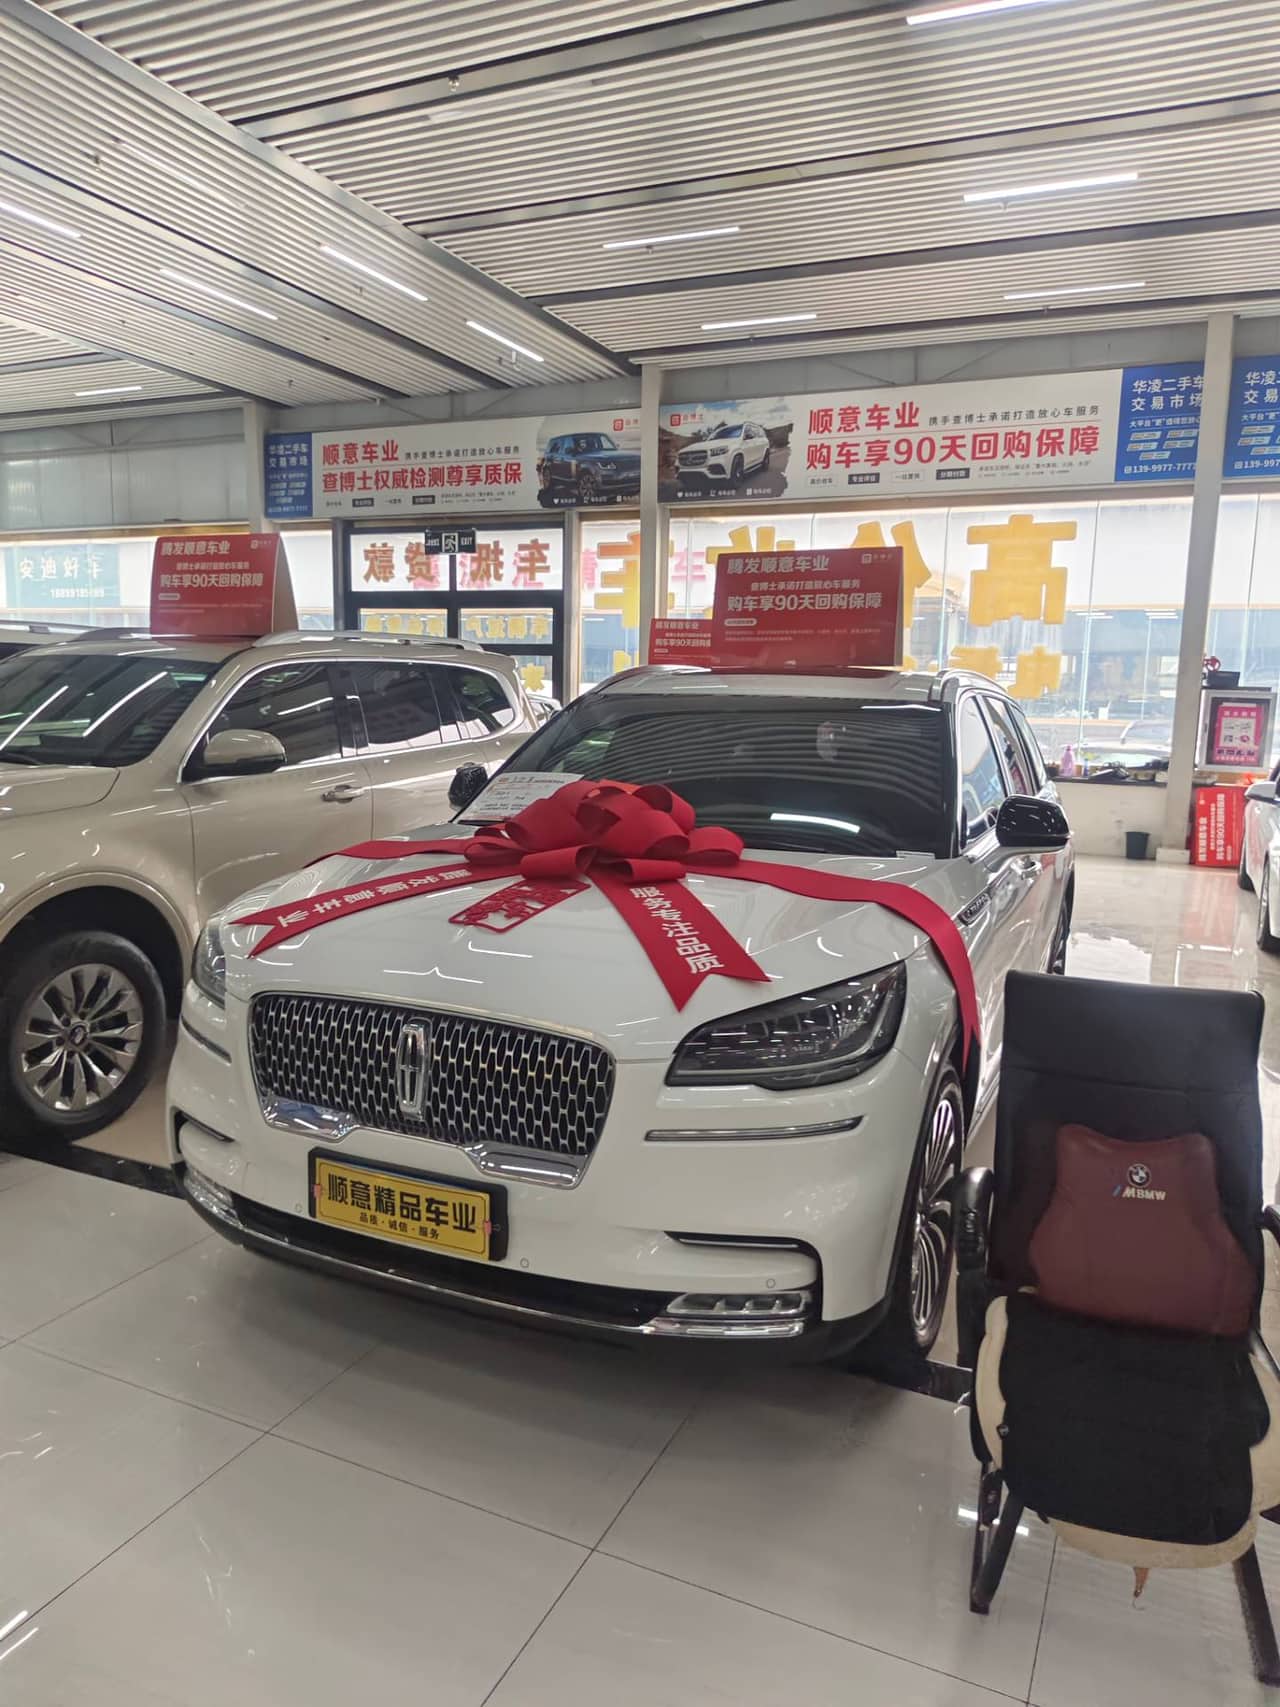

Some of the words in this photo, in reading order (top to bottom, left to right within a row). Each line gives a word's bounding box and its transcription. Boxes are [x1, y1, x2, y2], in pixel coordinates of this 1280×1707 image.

[1132, 376, 1204, 394] 华凌二手车
[1244, 370, 1280, 387] 华凌
[1131, 394, 1203, 412] 交易市场
[808, 400, 919, 434] 顺意车业
[929, 405, 1100, 427] 携手查博士承诺打造放心车服务
[322, 440, 400, 466] 顺意车业
[806, 426, 1100, 470] 购车享90天回购保障
[322, 462, 522, 493] 查博士权威检测尊享质保
[160, 572, 264, 589] 购车享90天回购保障
[727, 592, 882, 612] 购车享90天回购保障
[630, 886, 725, 974] 服务专注品质
[328, 1172, 477, 1234] 顺意精品车业
